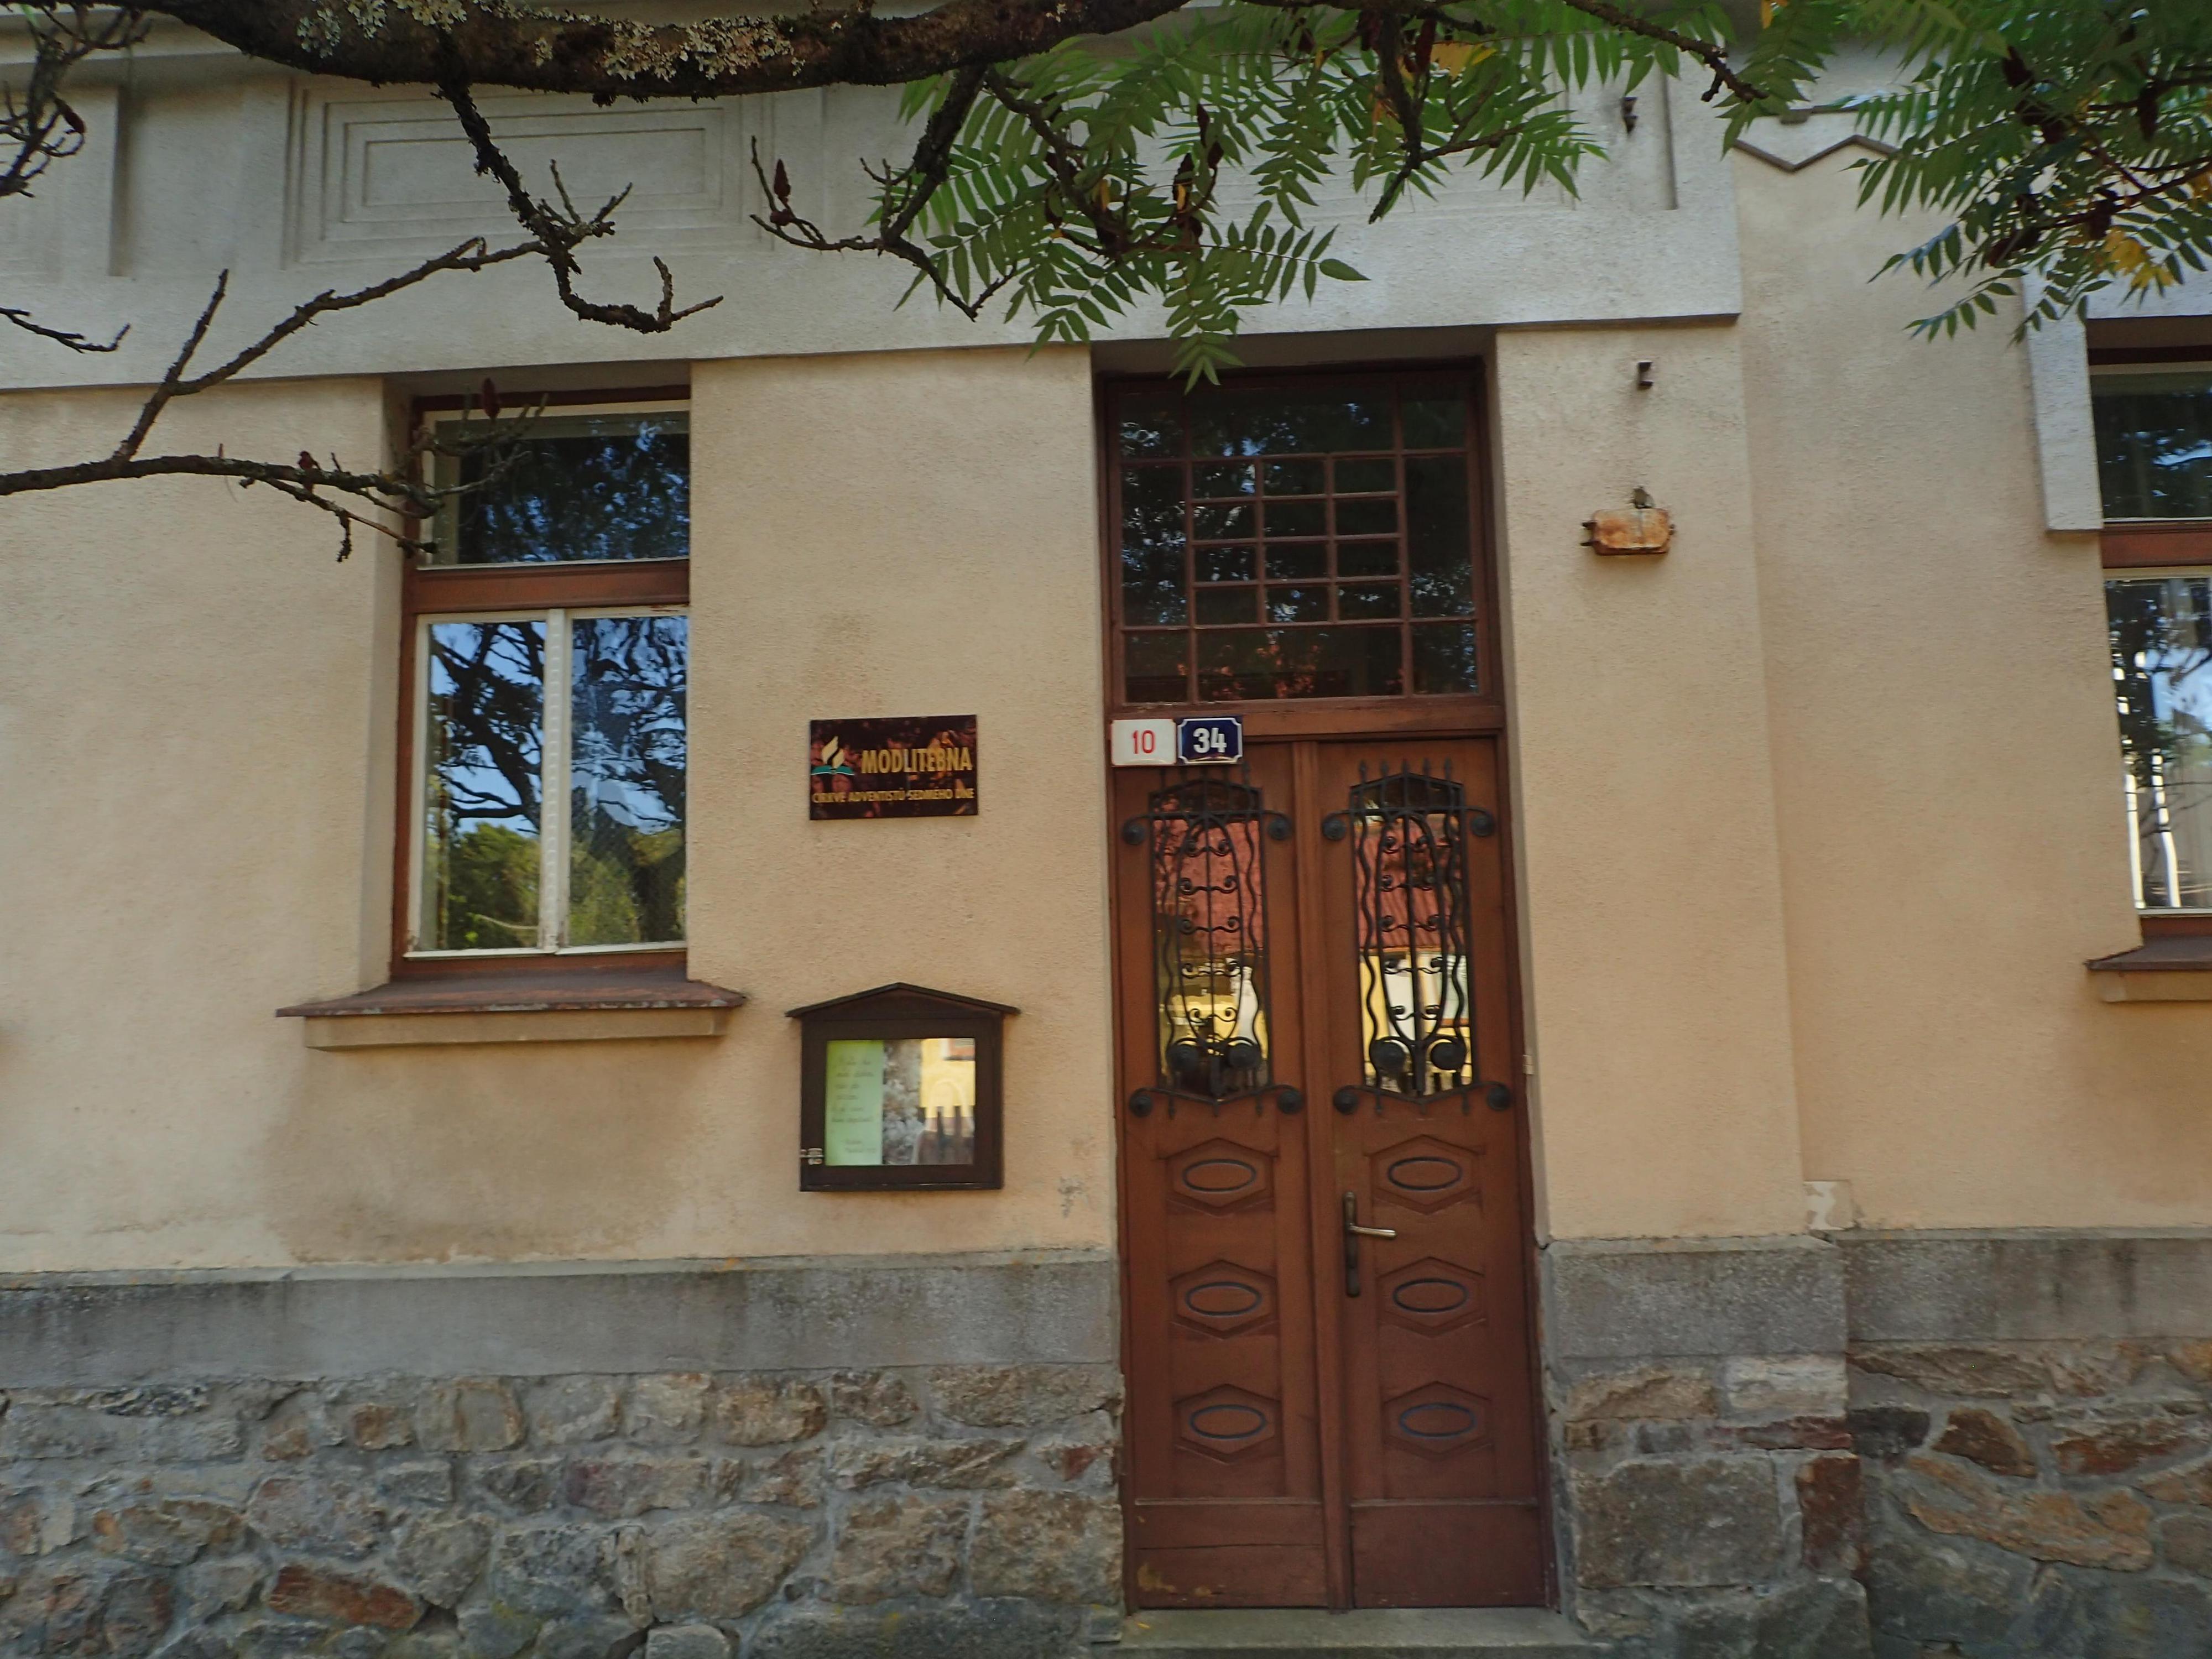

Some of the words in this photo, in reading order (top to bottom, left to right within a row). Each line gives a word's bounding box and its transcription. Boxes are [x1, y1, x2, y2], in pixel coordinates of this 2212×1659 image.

[1131, 729, 1155, 754] 10
[1193, 727, 1227, 753] 34
[862, 747, 972, 774] MODLITEBNA
